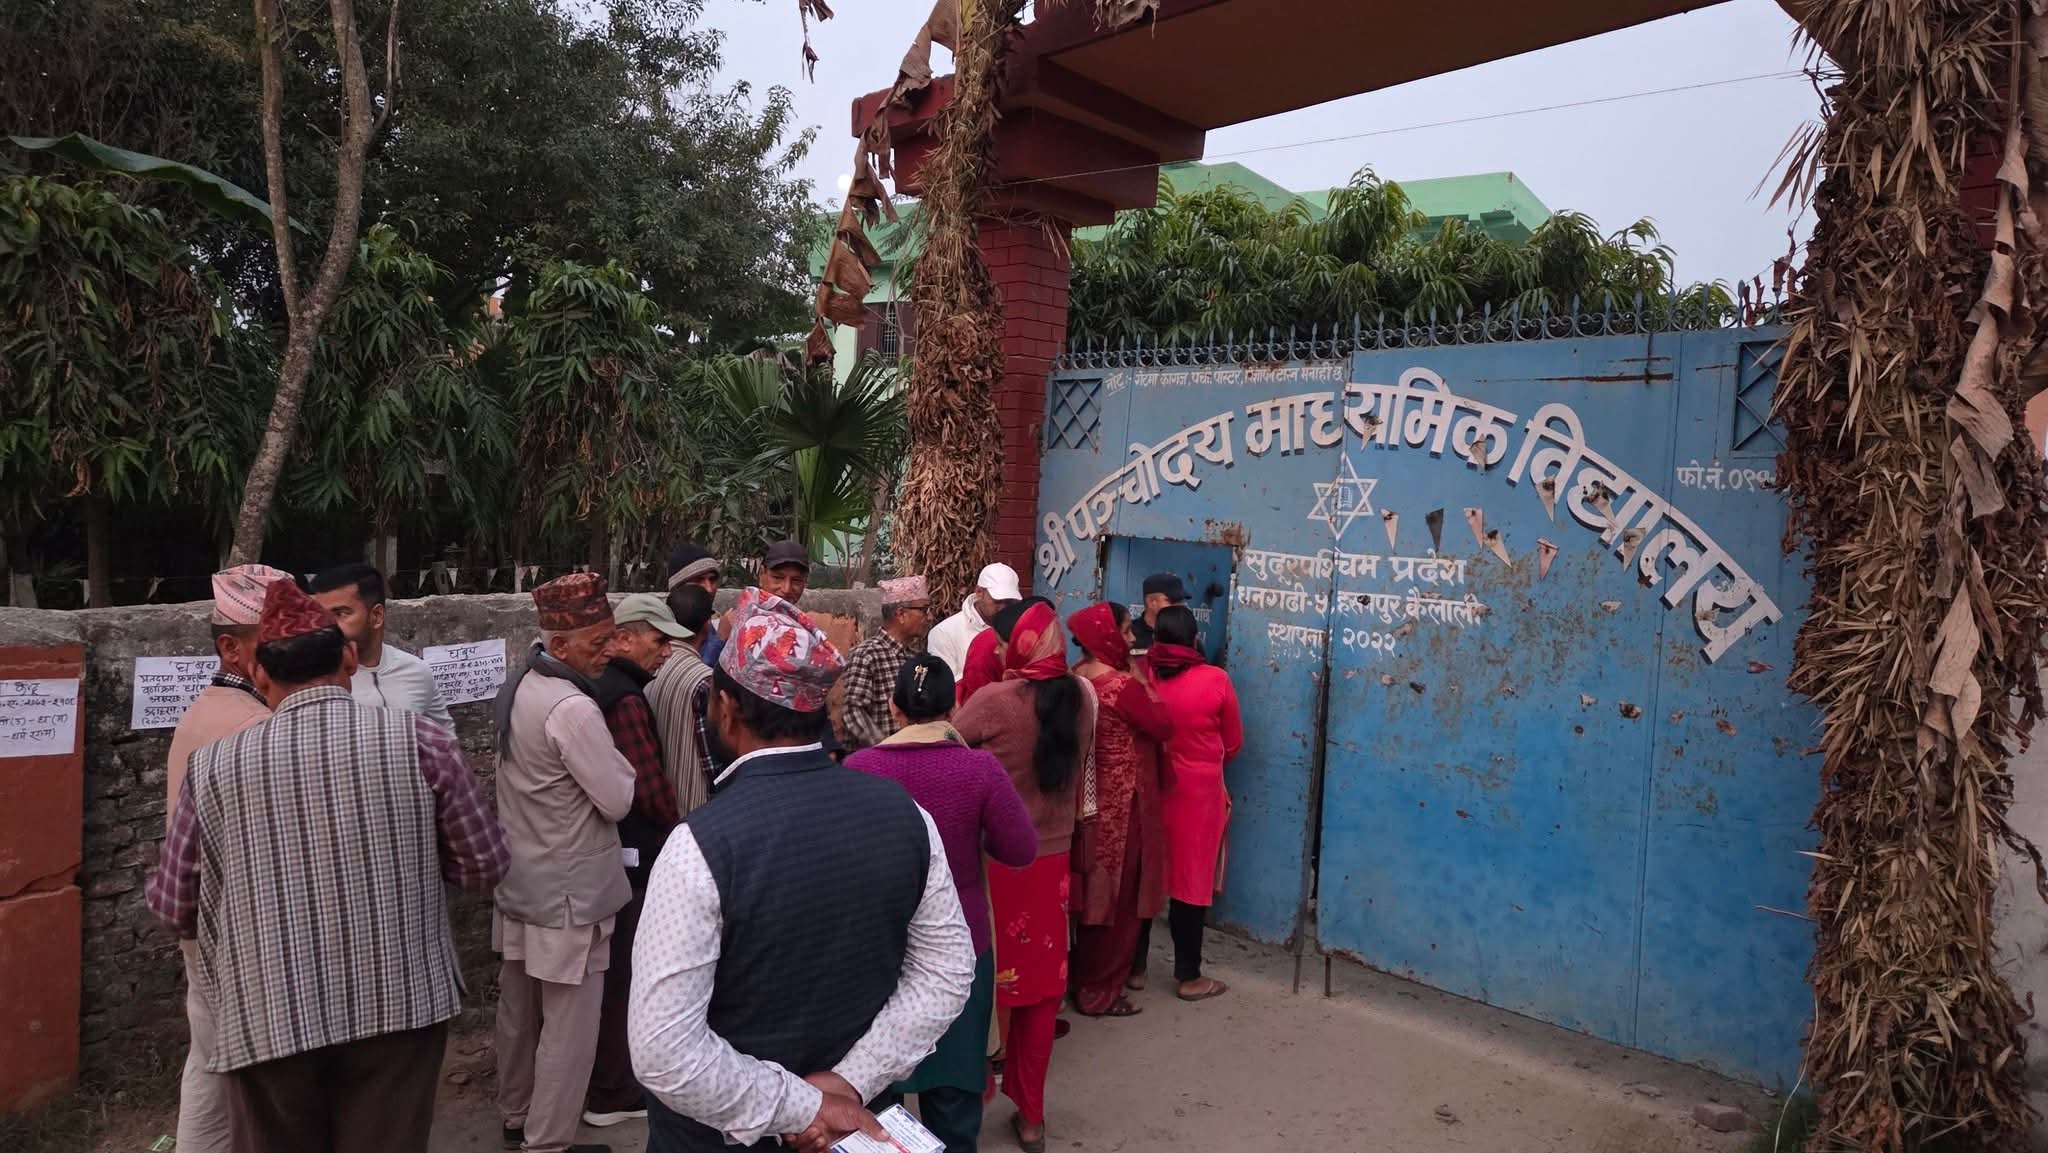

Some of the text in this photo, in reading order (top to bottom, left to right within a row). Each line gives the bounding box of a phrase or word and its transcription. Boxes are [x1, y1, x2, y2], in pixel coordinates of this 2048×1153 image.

[1038, 511, 1076, 588] श्री
[1245, 367, 1518, 467] माध्यमिक
[1506, 402, 1783, 664] विद्यालय
[1389, 548, 1467, 586] प्रदेश
[1342, 626, 1397, 658] २०२२
